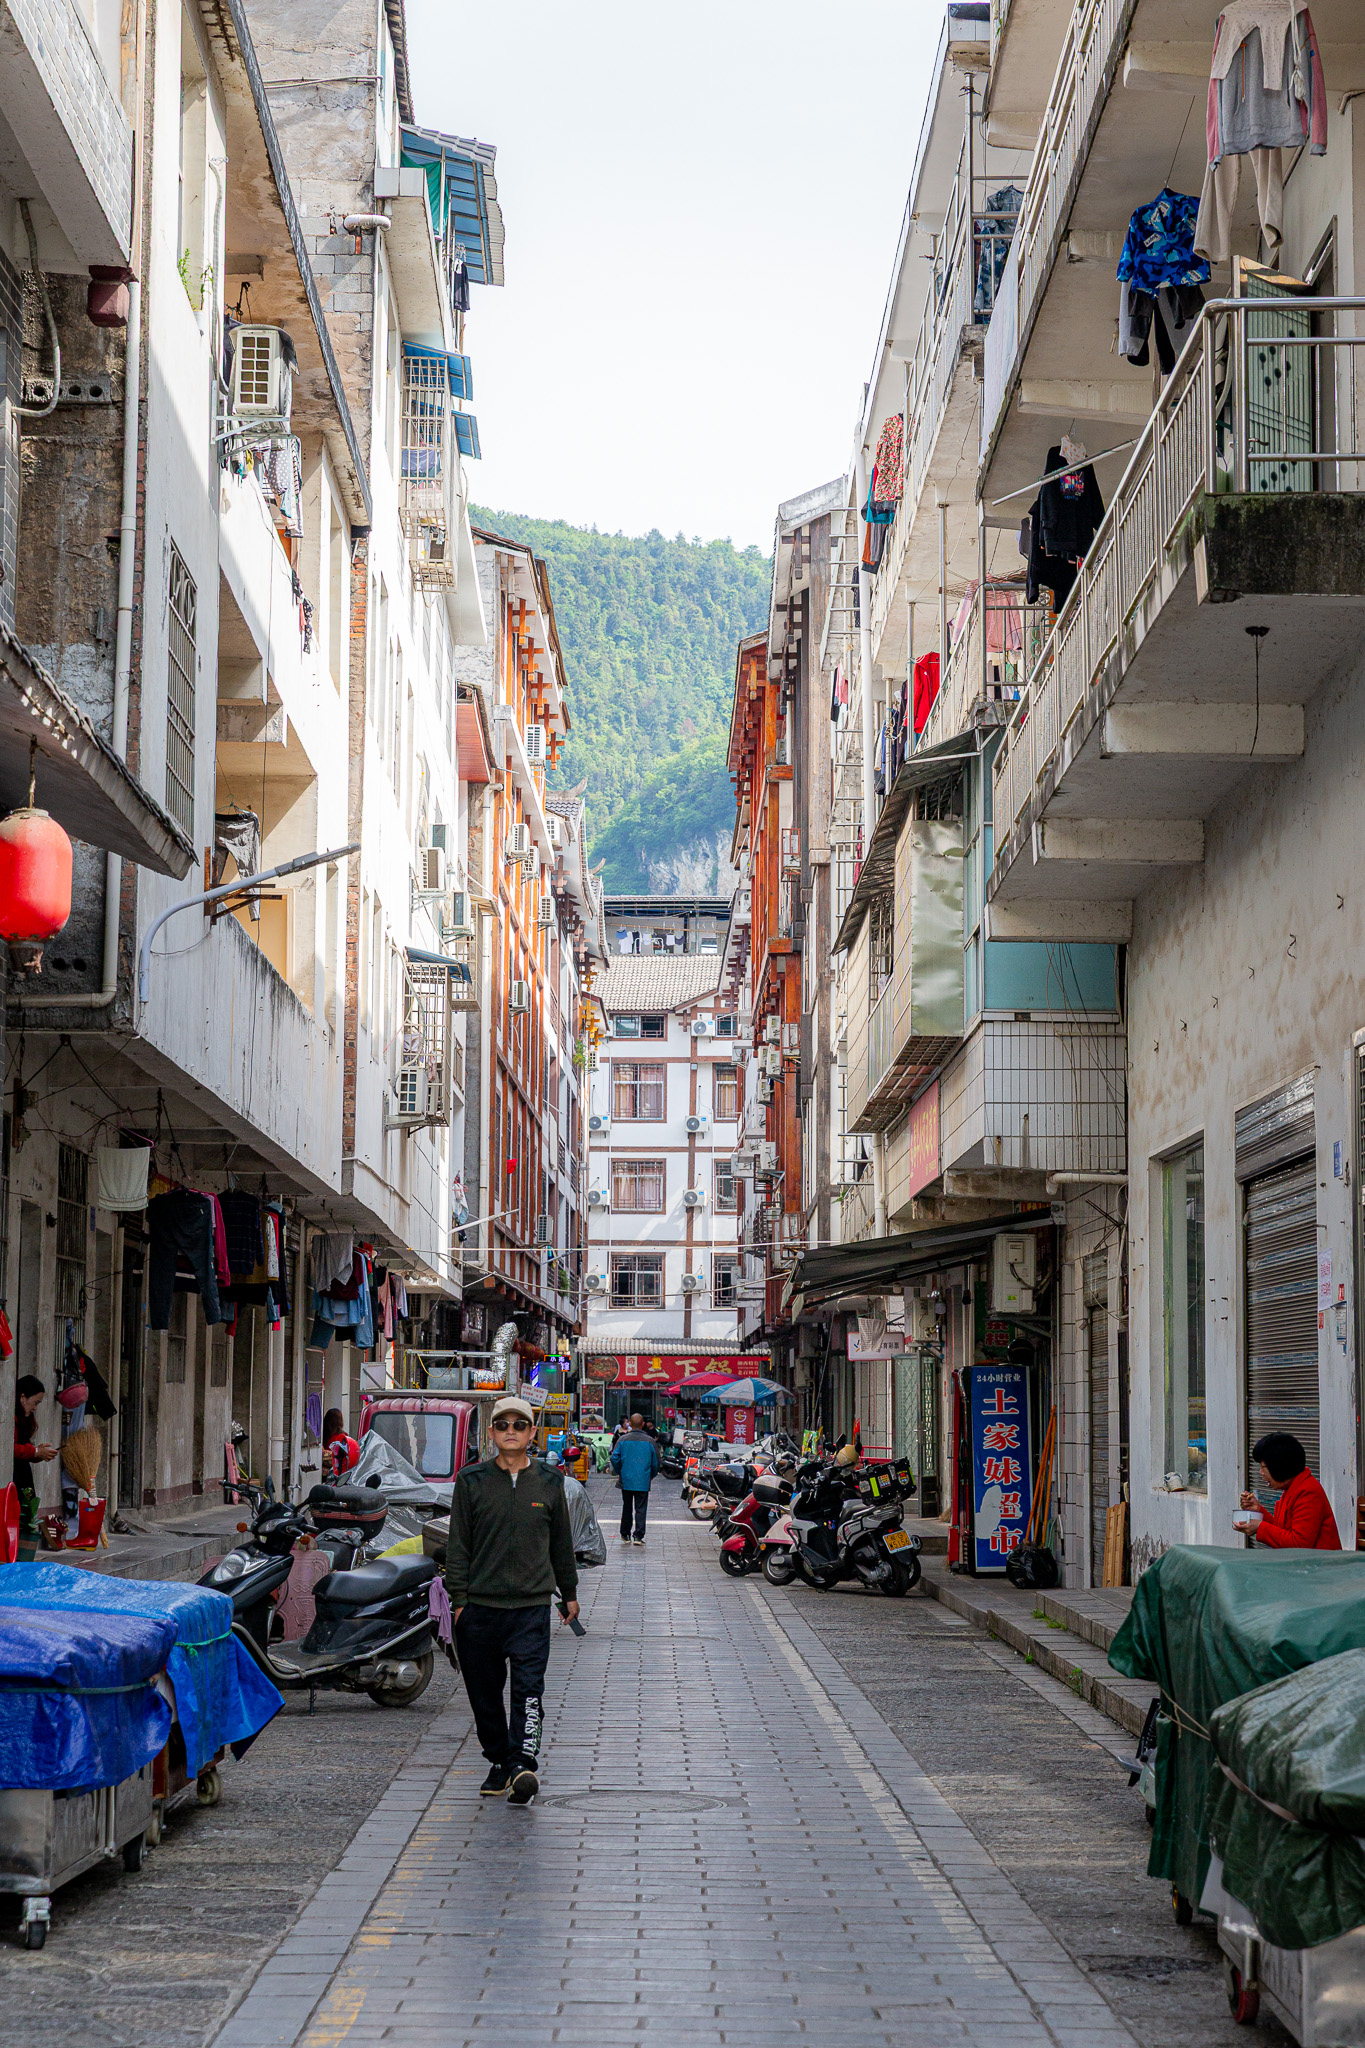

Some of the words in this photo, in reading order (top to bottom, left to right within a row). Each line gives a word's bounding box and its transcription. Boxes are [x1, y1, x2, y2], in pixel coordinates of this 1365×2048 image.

[642, 1358, 733, 1379] 三下锅
[976, 1373, 1022, 1383] 24小时营业
